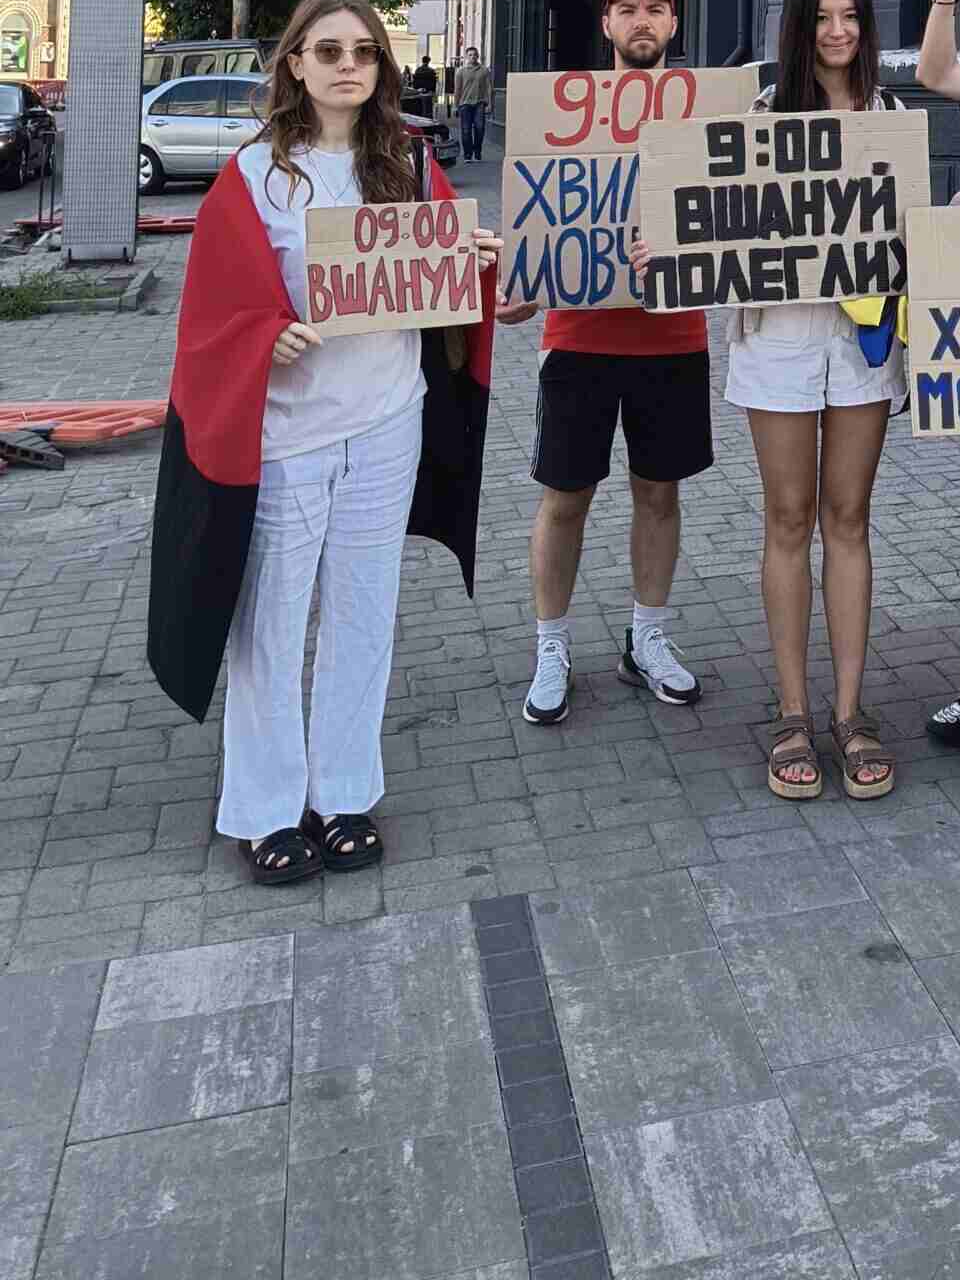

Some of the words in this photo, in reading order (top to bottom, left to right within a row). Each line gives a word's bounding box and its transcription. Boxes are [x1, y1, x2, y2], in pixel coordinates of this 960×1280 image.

[544, 68, 697, 147] 9:00
[706, 117, 842, 177] 9:00
[354, 201, 459, 253] 09:00
[674, 161, 897, 245] ВШАНУЙ
[308, 247, 477, 324] ВШАНУЙ
